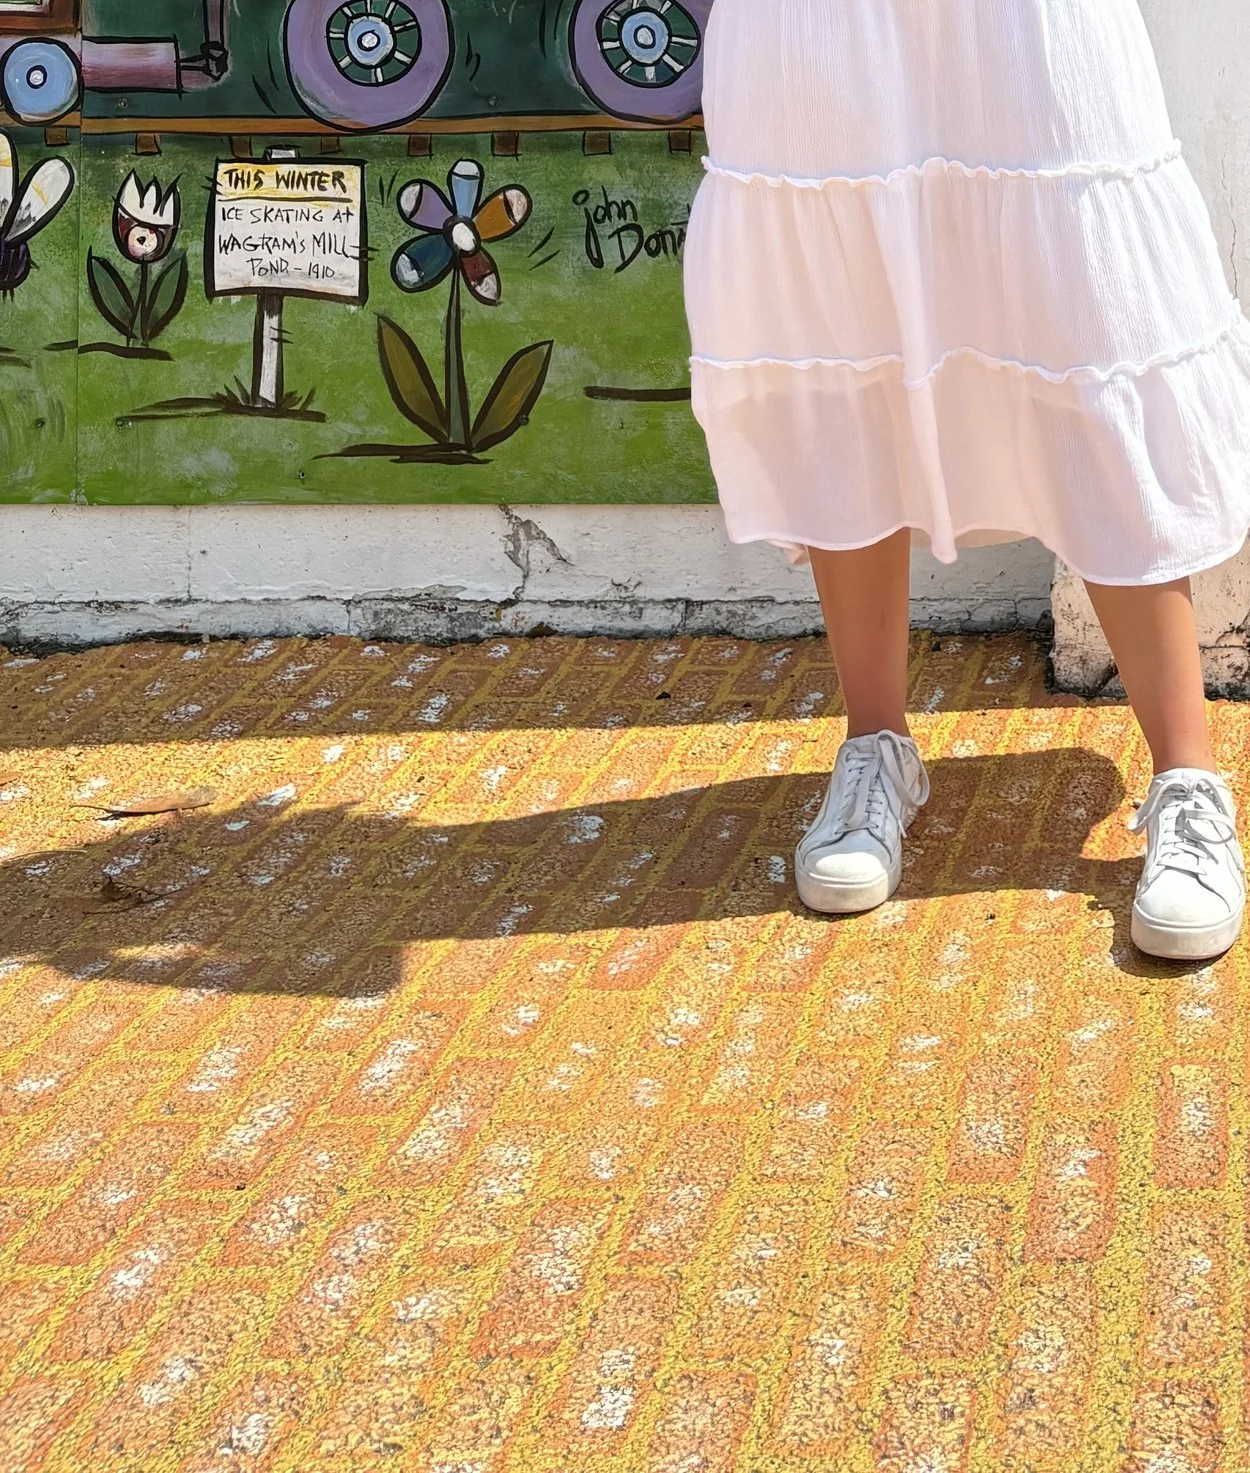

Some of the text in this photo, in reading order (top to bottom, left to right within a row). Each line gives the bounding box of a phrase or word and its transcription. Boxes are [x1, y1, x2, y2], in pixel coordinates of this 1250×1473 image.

[223, 168, 347, 194] THIS WINTER
[221, 205, 325, 224] ICE SKATING
[311, 231, 350, 258] MILL
[307, 261, 336, 280] 1910
